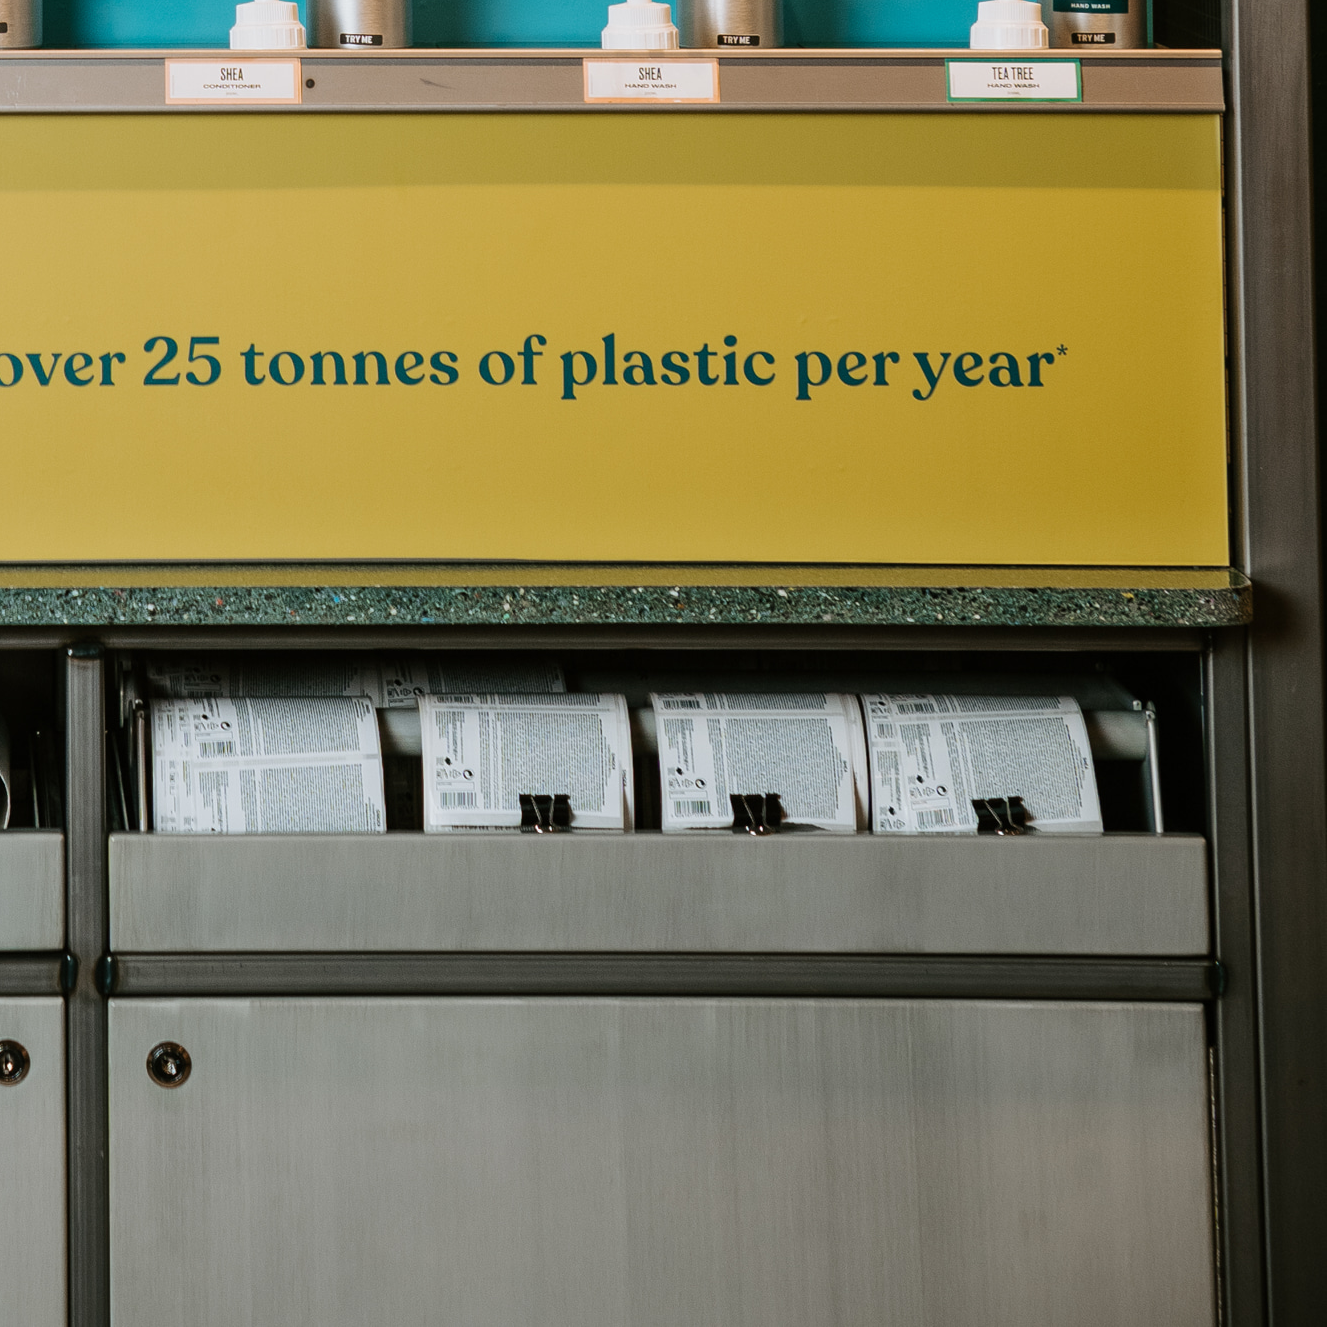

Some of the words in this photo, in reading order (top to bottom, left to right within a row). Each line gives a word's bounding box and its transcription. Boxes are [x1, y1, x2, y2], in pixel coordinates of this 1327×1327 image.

[1076, 34, 1092, 43] TRY
[1093, 34, 1106, 43] ME
[638, 67, 663, 80] SHEA
[992, 67, 1010, 80] TEA
[1010, 67, 1035, 80] TREE
[143, 335, 222, 386] 25
[239, 343, 459, 386] tonnes
[478, 333, 548, 386] of
[559, 332, 776, 401] plastic
[794, 351, 901, 401] per
